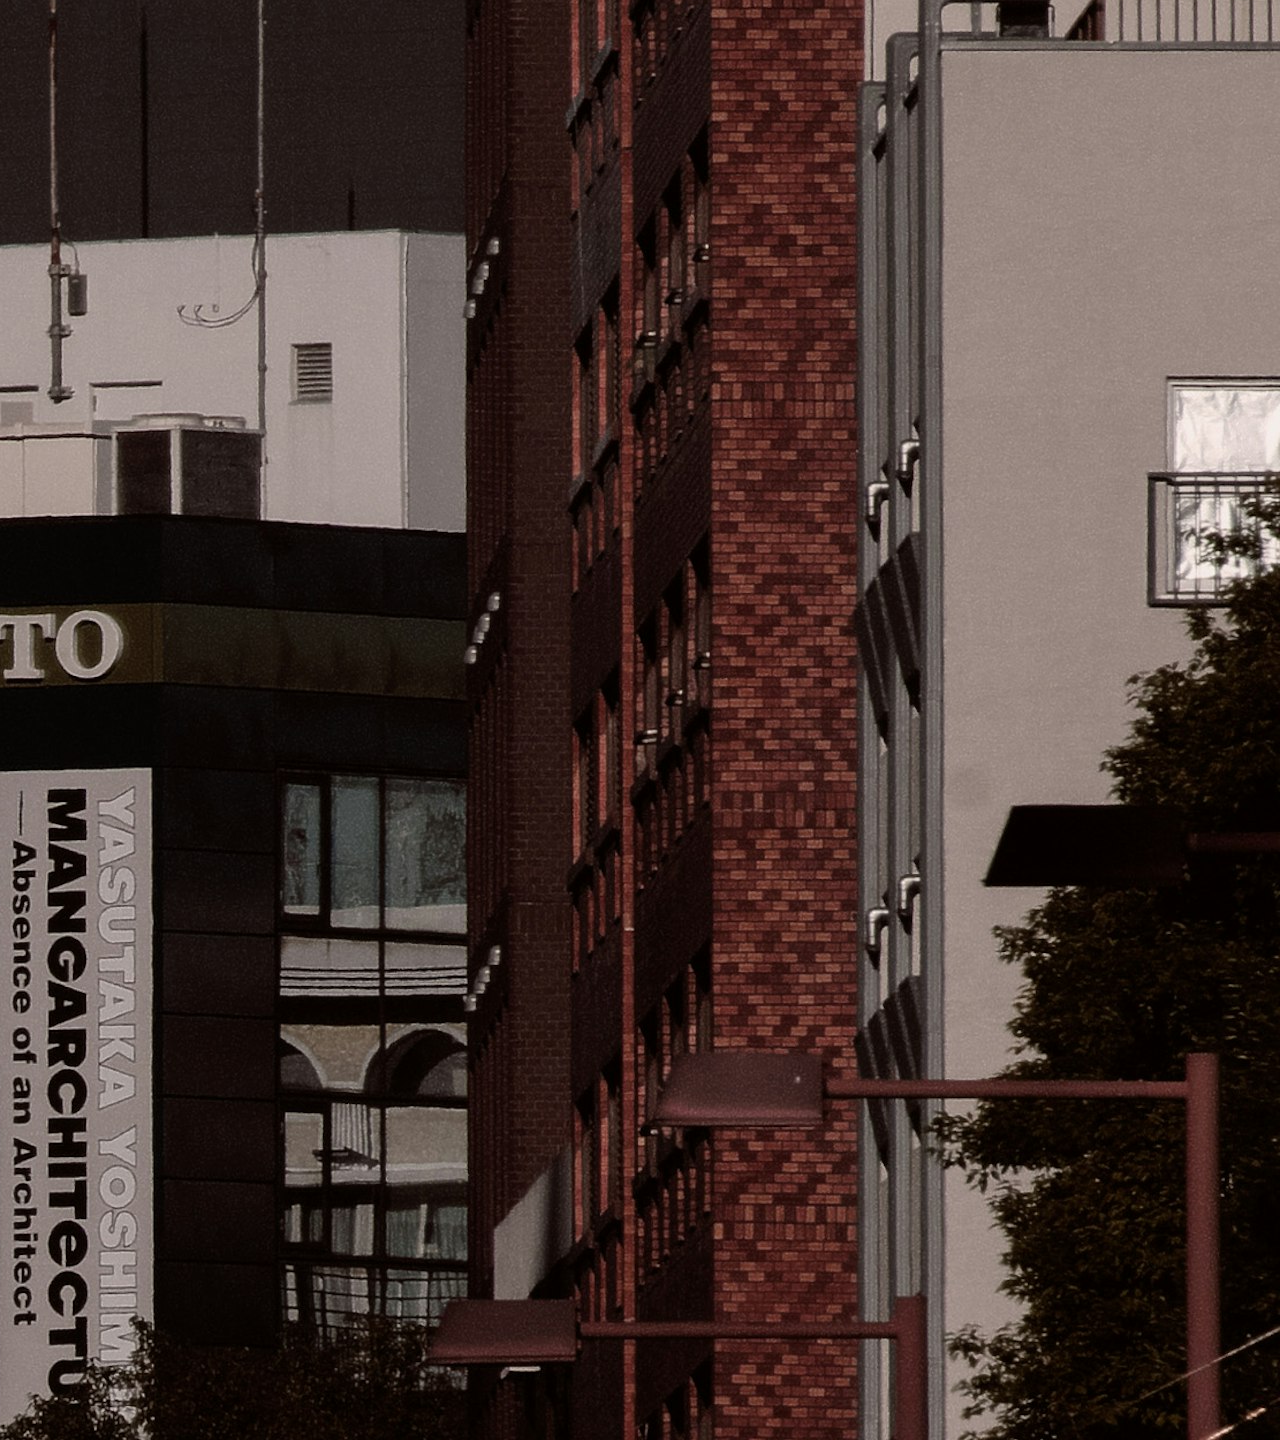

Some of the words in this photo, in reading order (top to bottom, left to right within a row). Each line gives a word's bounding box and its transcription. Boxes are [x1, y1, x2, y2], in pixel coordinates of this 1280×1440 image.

[97, 786, 137, 1110] YASUTAKA
[12, 1026, 37, 1064] of
[12, 1076, 32, 1125] an
[12, 1137, 38, 1326] Architect
[97, 1124, 138, 1365] YOSHIM
